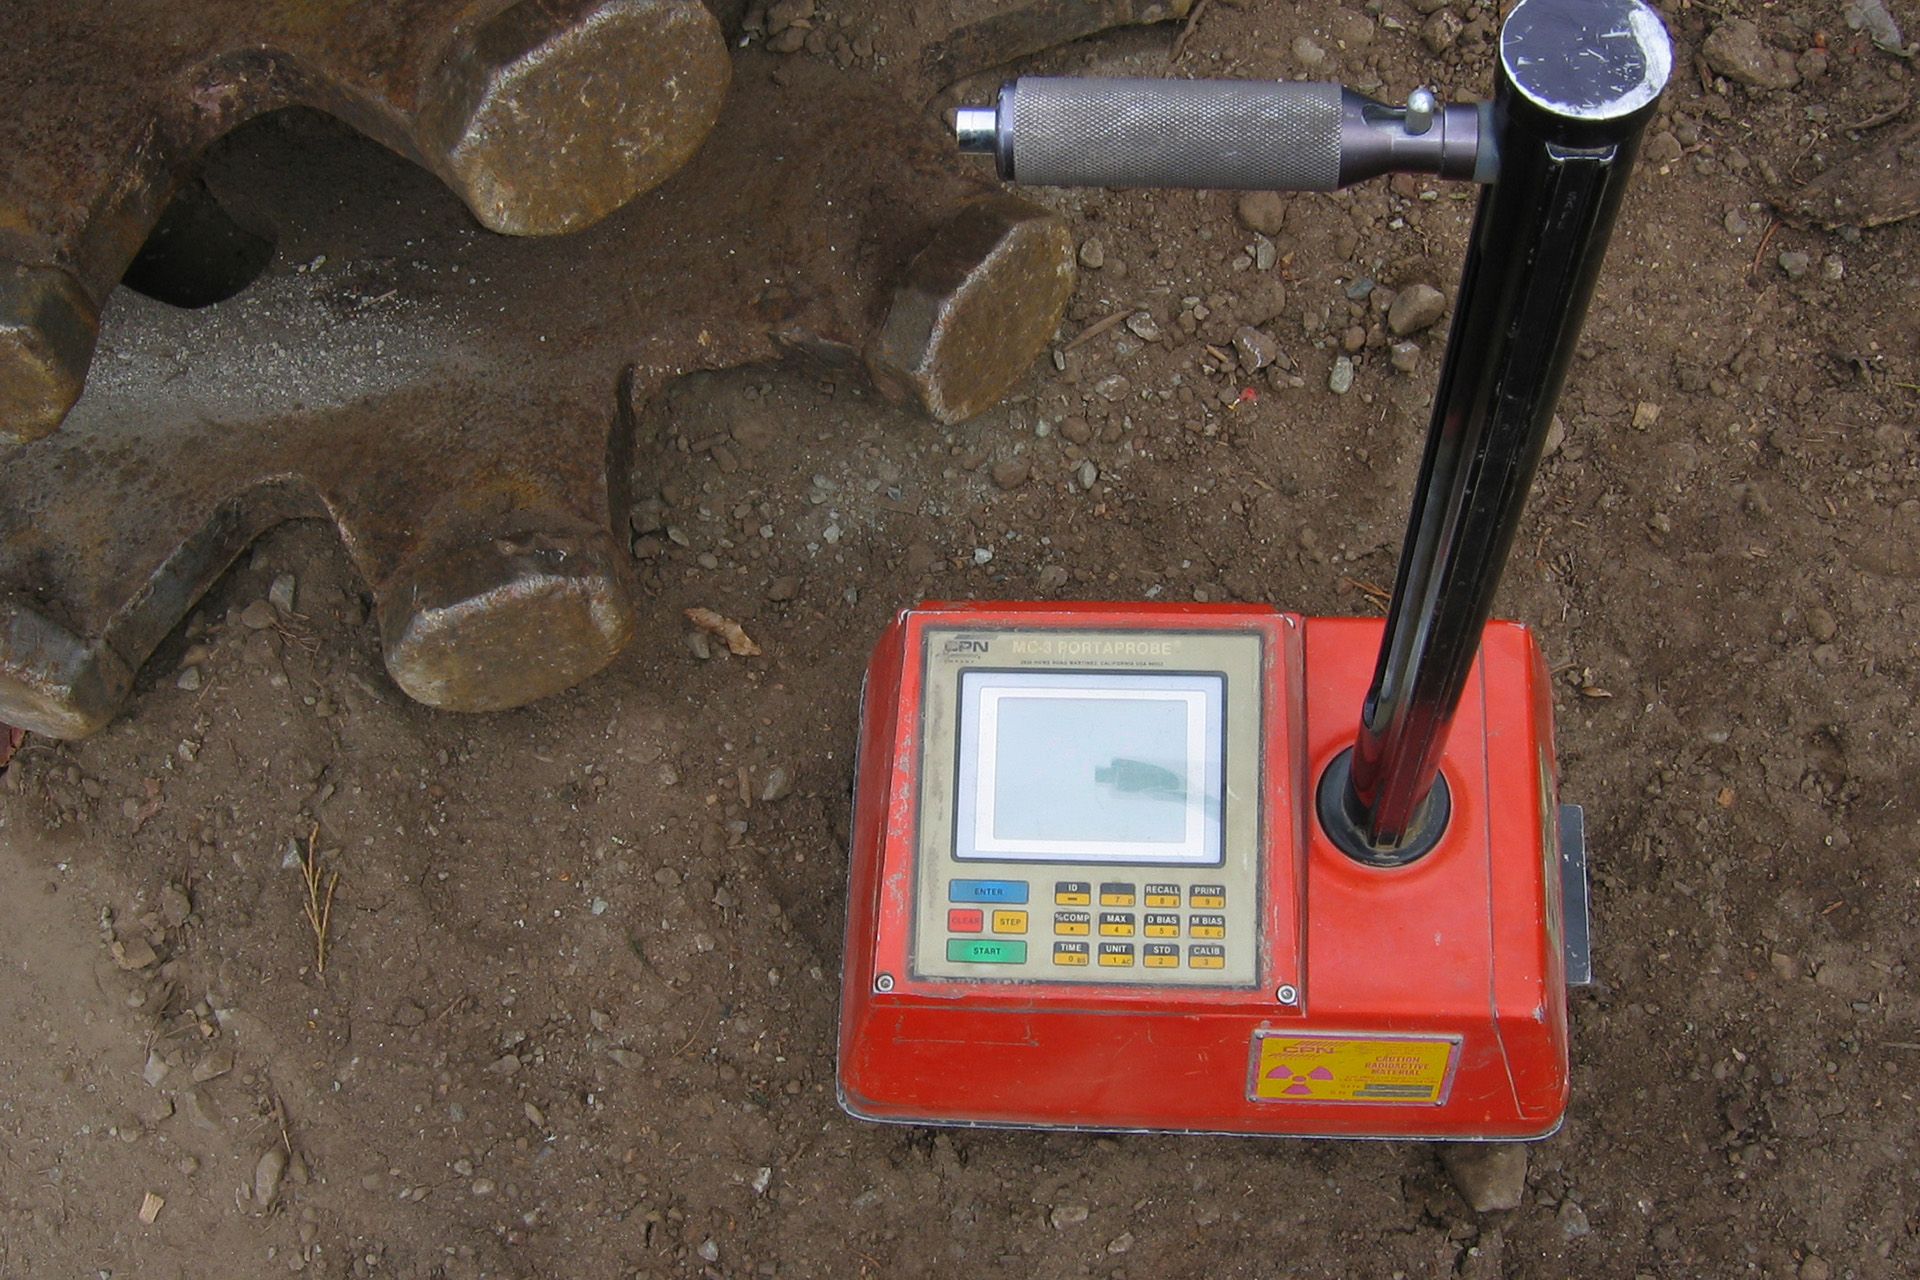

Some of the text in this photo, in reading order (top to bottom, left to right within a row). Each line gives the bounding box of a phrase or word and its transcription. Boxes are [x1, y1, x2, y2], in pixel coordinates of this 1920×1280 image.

[1012, 640, 1172, 655] MC-3 PORTAPROBE
[974, 887, 1003, 895] ENTER
[1068, 883, 1078, 892] ID
[1146, 885, 1180, 894] RECALL
[1194, 887, 1221, 895] PRINT
[1000, 918, 1021, 926] STEP
[1055, 914, 1090, 922] %COMP
[1106, 914, 1126, 922] MAX
[1147, 915, 1177, 924] D BIAS
[1202, 917, 1222, 925] BIAS
[973, 946, 1001, 956] START
[1061, 943, 1082, 952] TIME
[1105, 945, 1127, 953] UNIT
[1153, 946, 1171, 954] STD
[1194, 947, 1220, 955] CALIB
[1158, 957, 1163, 965] 2
[1364, 1062, 1430, 1070] RADIOACTIVE
